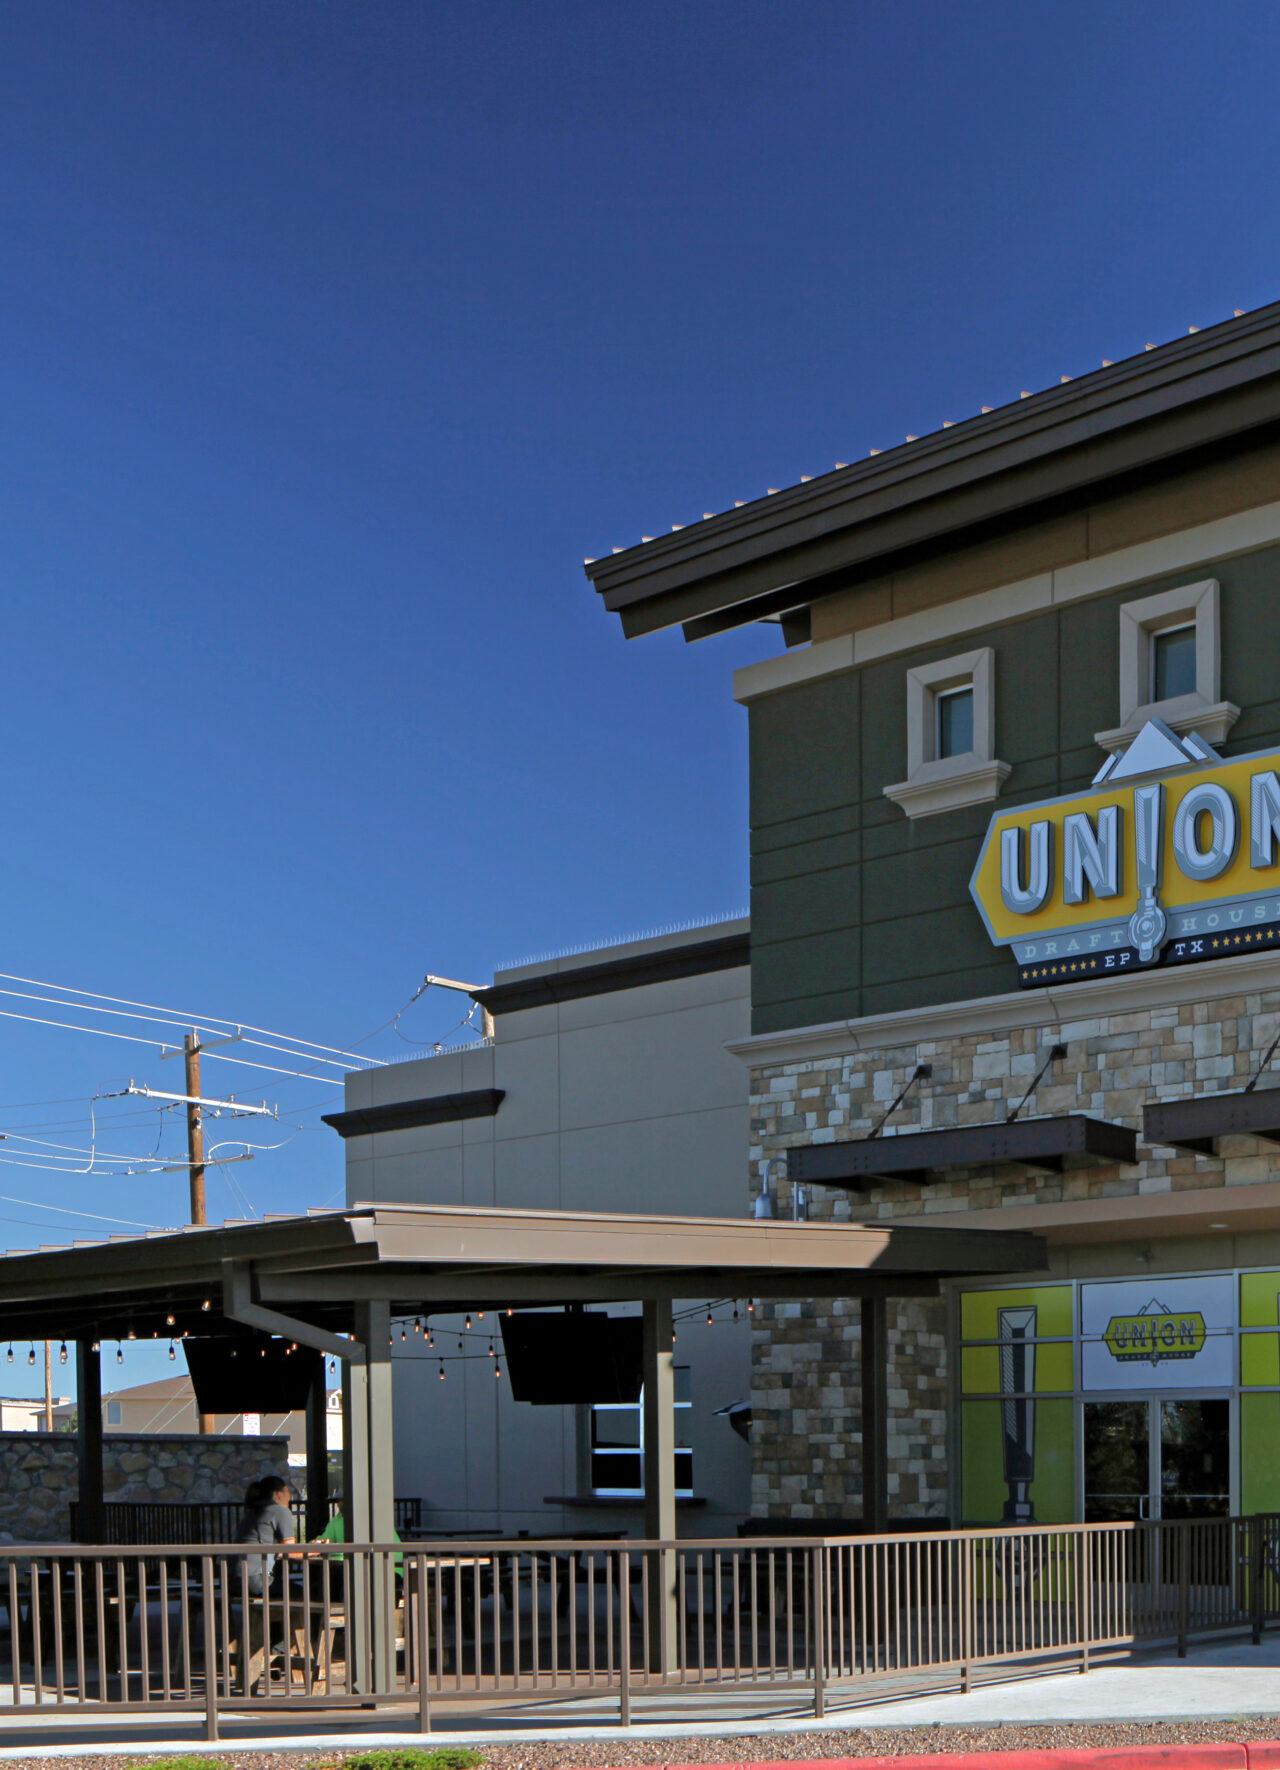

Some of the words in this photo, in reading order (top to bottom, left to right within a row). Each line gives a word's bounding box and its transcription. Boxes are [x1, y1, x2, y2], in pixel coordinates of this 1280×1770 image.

[1024, 930, 1124, 959] DRAFT
[1104, 953, 1131, 968] EP
[1175, 940, 1204, 956] TX
[1115, 1319, 1196, 1349] UNION
